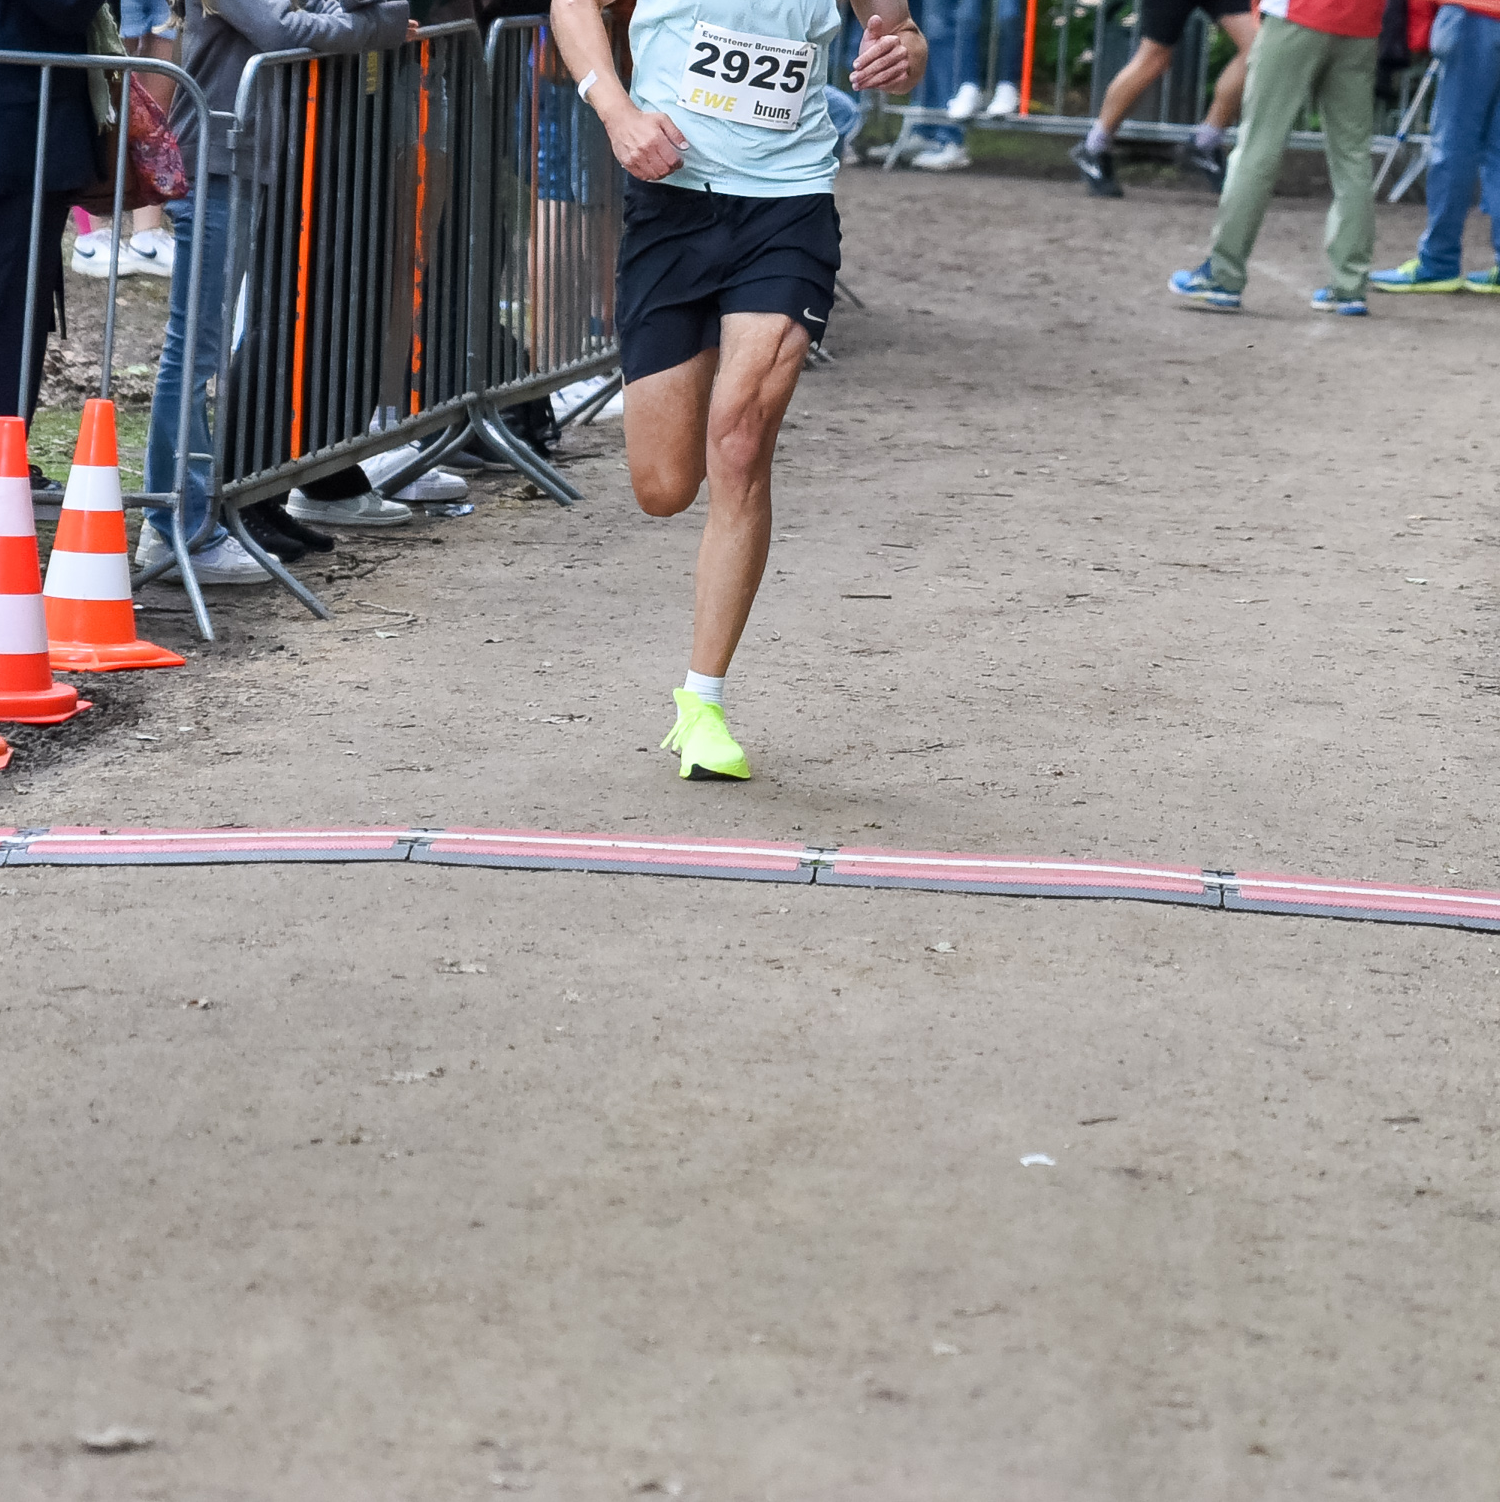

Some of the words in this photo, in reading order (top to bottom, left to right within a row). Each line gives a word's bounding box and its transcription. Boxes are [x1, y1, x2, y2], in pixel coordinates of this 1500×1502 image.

[702, 30, 753, 49] Everstener
[754, 42, 808, 57] Brunnenlauf
[688, 41, 808, 94] 2925
[690, 88, 738, 112] EWE
[753, 100, 792, 120] bruns
